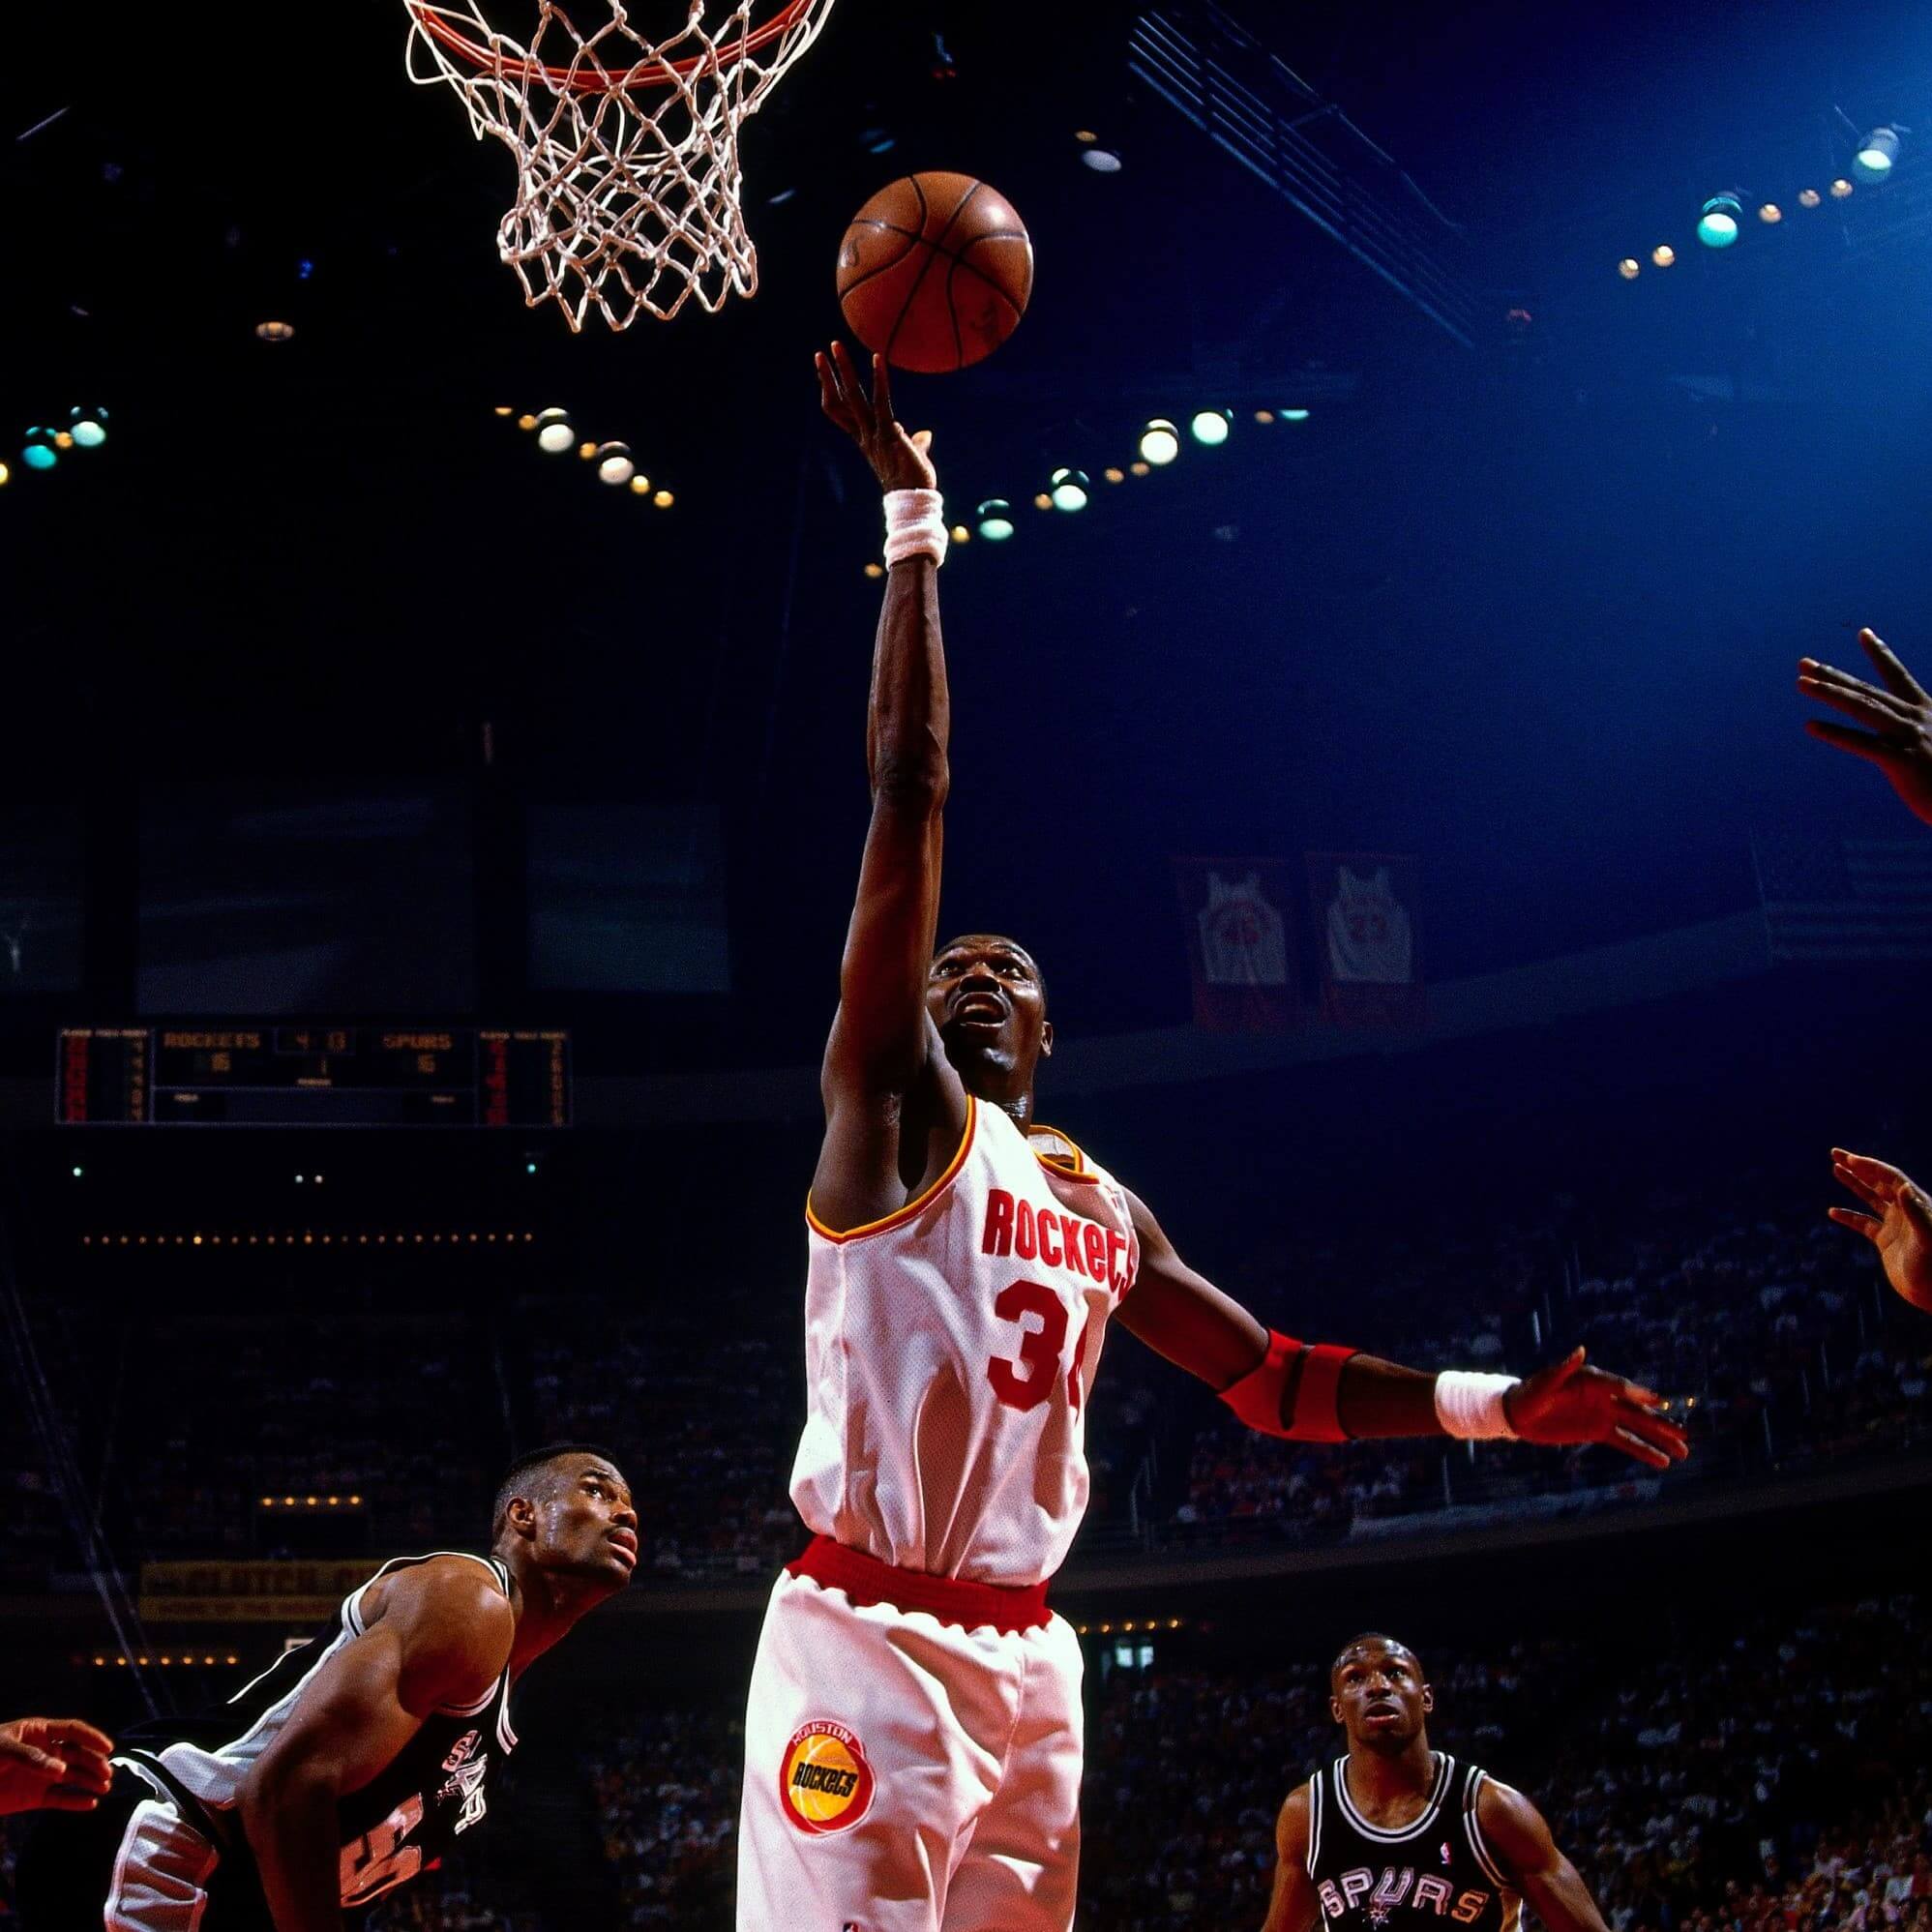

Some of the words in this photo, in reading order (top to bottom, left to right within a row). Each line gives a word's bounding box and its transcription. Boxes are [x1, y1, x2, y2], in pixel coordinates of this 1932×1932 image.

[163, 1031, 260, 1049] ROCKETS
[383, 1033, 452, 1050] SPURS
[792, 1722, 852, 1746] HOUSTON
[1317, 1866, 1489, 1925] SPURS
